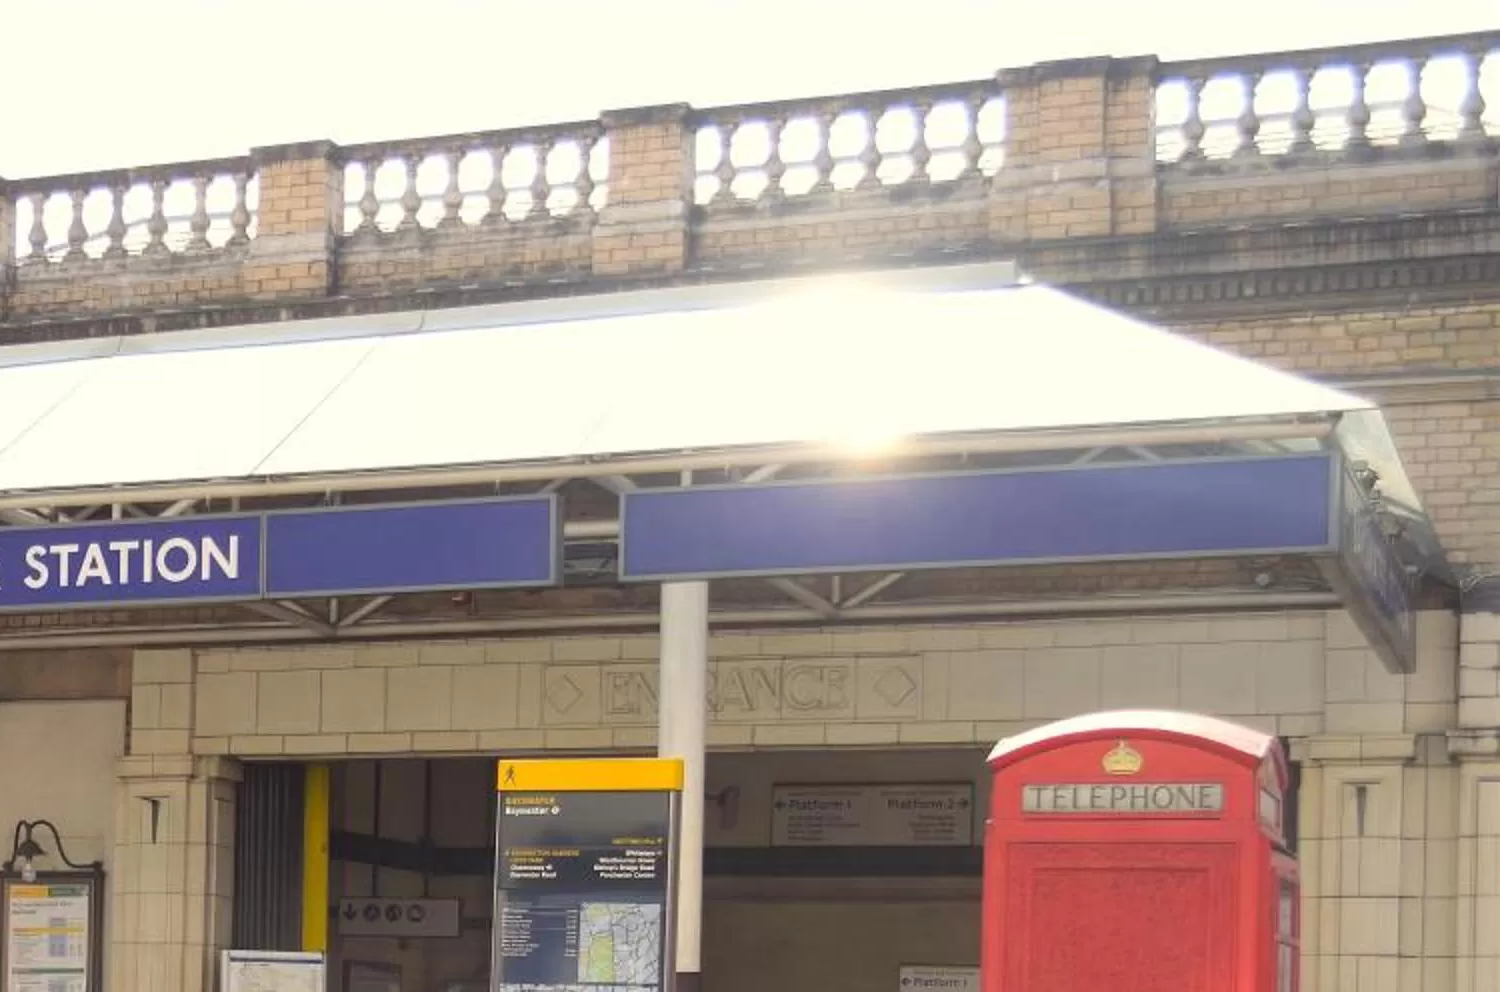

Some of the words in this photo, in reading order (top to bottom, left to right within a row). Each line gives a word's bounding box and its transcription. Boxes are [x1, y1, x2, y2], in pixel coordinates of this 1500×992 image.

[23, 535, 240, 589] STATION
[604, 664, 850, 717] ENRANCE
[1028, 785, 1213, 810] TELEPHONE
